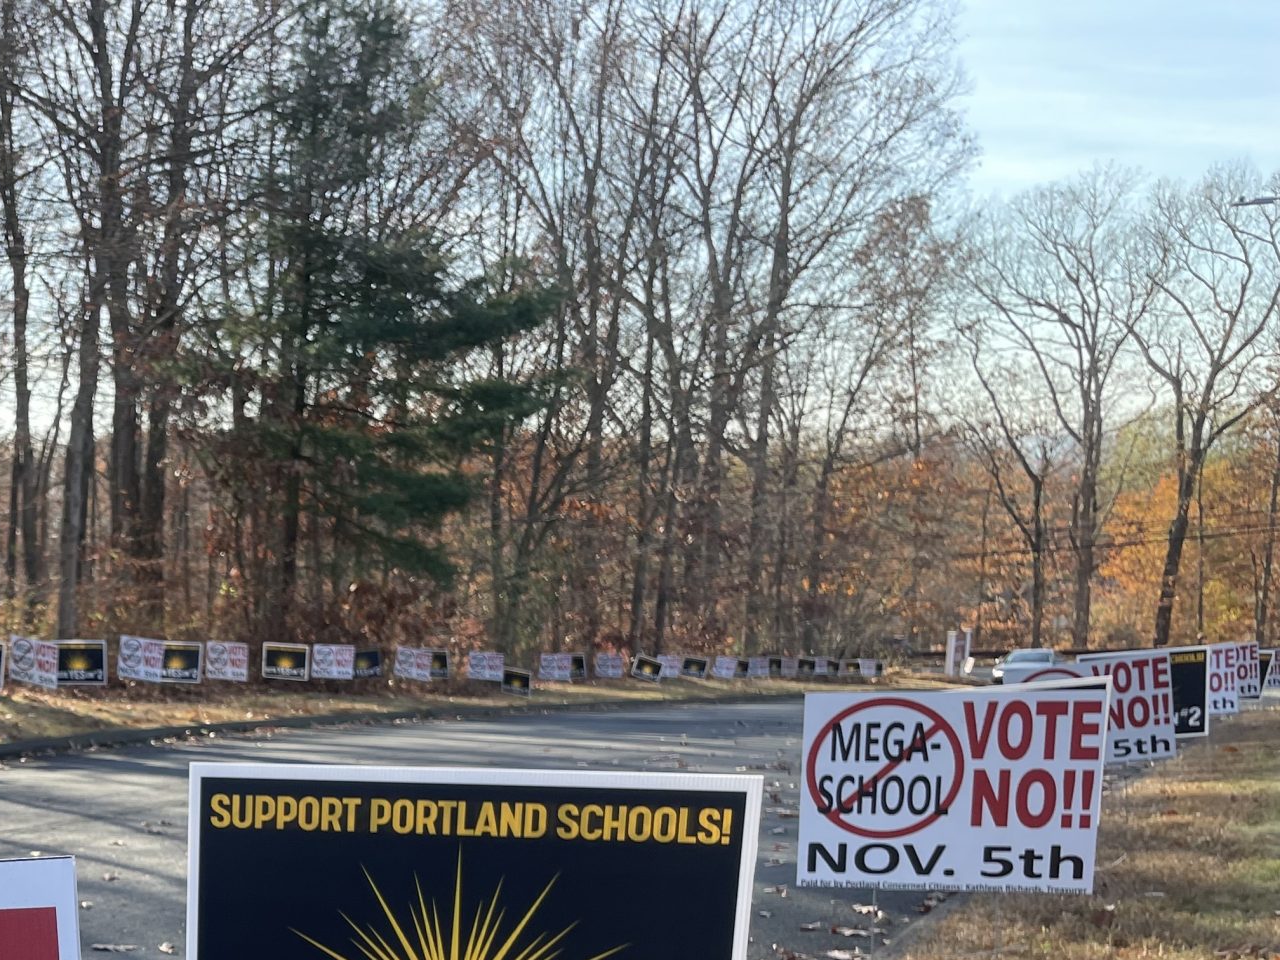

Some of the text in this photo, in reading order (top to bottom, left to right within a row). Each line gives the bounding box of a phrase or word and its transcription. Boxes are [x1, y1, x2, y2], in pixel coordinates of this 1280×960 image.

[1209, 672, 1235, 692] O!!
[1237, 663, 1258, 680] O!!
[963, 700, 1102, 760] VOTE
[1108, 694, 1170, 731] NO!!
[831, 722, 941, 763] MEGA-
[1114, 734, 1170, 758] 5th
[817, 774, 948, 815] SCHOOL
[970, 768, 1095, 829] NO!!
[210, 793, 732, 846] SUPPORT PORTLAND SCHOOLS!
[807, 842, 1084, 880] NOV. 5th
